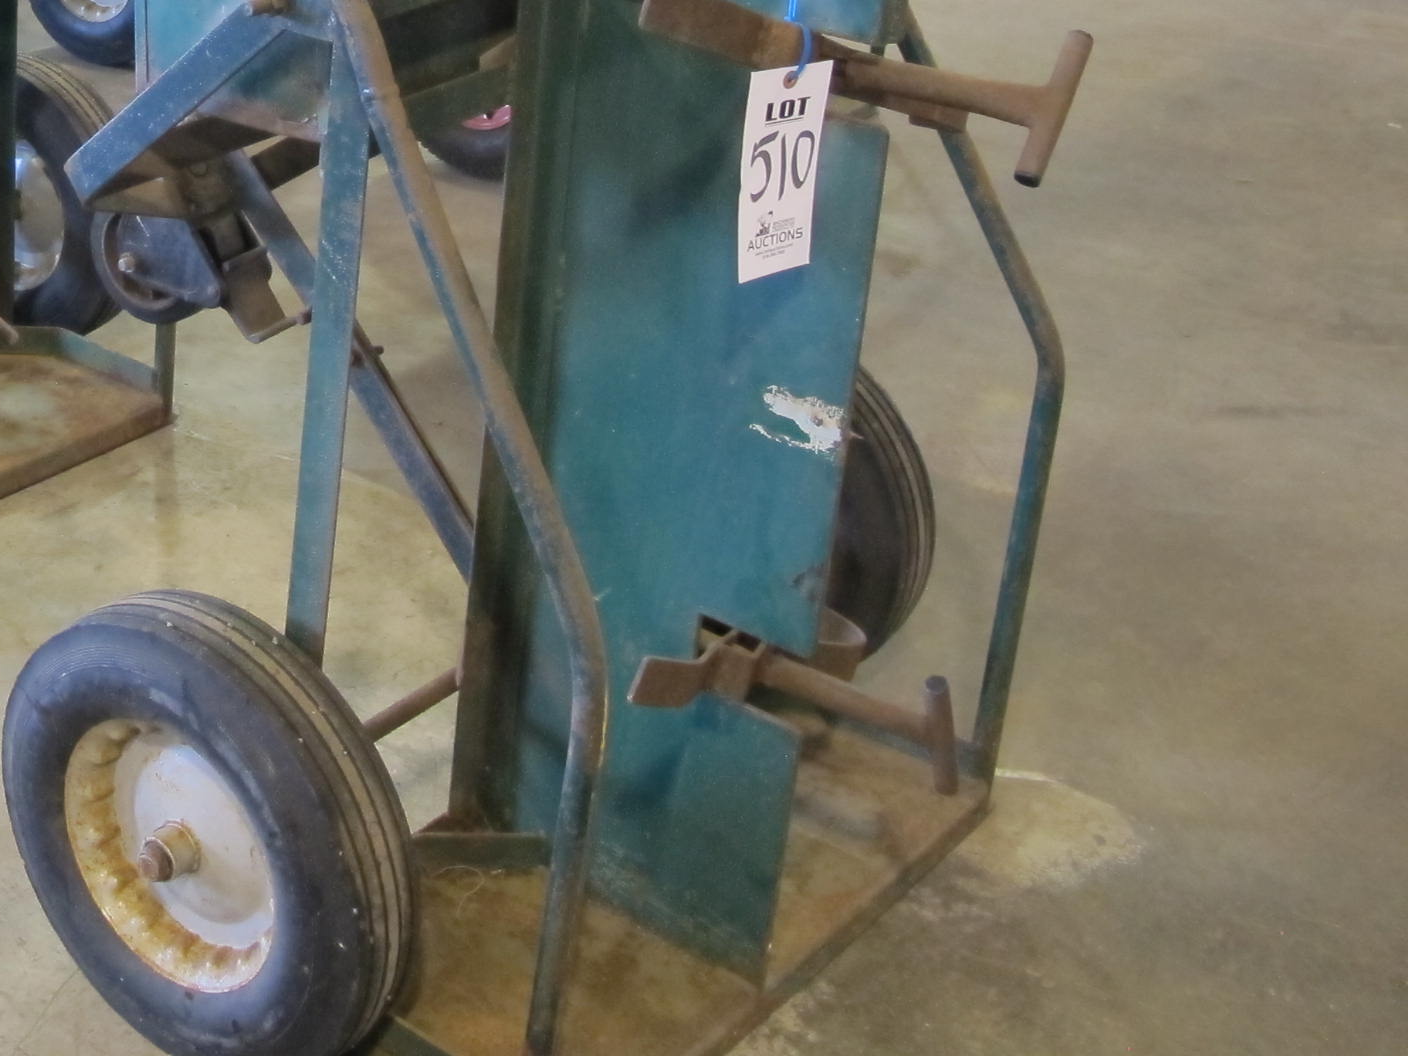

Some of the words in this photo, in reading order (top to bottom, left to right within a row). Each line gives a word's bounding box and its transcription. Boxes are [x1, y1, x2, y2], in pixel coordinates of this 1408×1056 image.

[765, 96, 812, 123] LOT
[749, 130, 816, 204] 510
[746, 226, 804, 253] AUCTIONS
